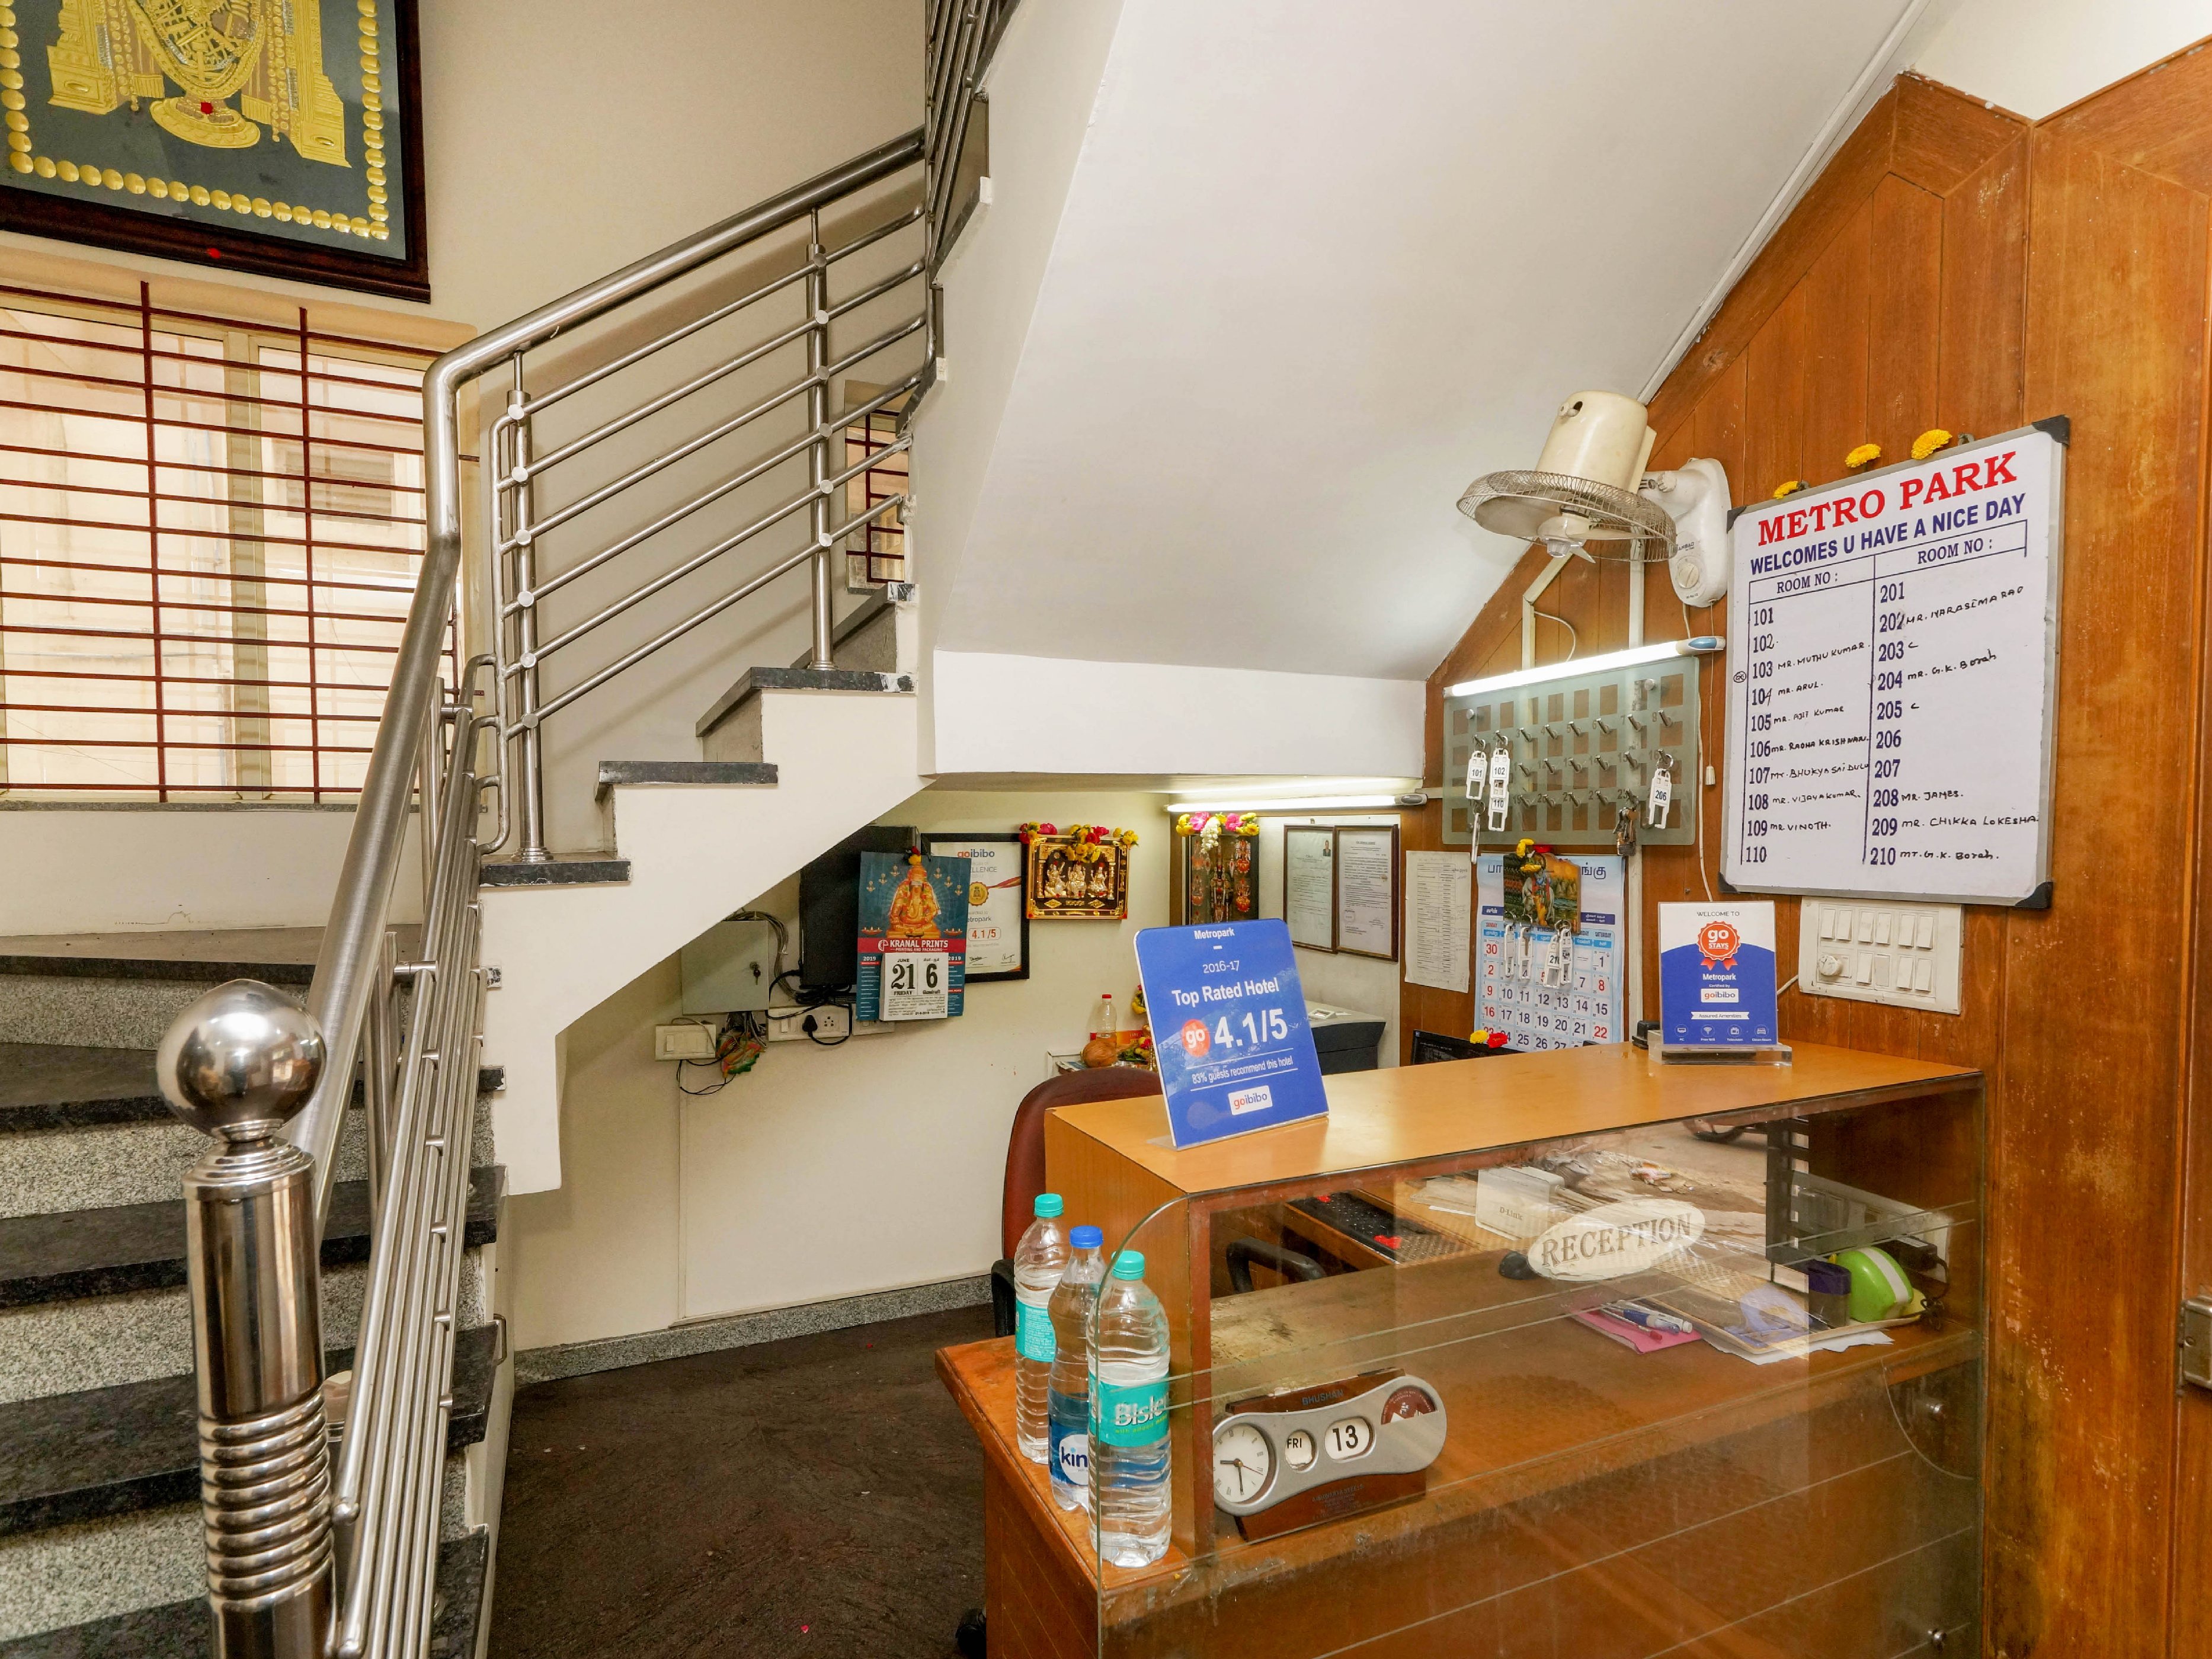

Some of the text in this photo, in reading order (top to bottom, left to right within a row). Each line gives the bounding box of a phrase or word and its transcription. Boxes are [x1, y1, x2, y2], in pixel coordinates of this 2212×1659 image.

[1758, 451, 2017, 546] METRO PARK
[1750, 493, 2026, 575] WELCOMES U HAVE A NICE DAY
[1918, 543, 1959, 564] ROOM
[1777, 577, 1810, 594] ROOM
[1880, 581, 1904, 603] 201
[1754, 607, 1774, 626] 101
[1797, 652, 1829, 666] MUTHU
[1878, 640, 1904, 662] 203
[1753, 661, 1773, 679] 103
[1878, 670, 1903, 691] 204
[1752, 688, 1772, 706] 104
[1877, 700, 1902, 720] 205
[1751, 713, 1772, 732] 105
[1876, 729, 1902, 749] 206
[1750, 741, 1771, 758] 106
[1472, 769, 1482, 777] 101
[1749, 767, 1771, 784] 107
[1874, 759, 1900, 779] 207
[1493, 800, 1504, 808] 110
[1655, 790, 1667, 800] 206
[1749, 793, 1769, 811] 108
[1873, 789, 1899, 807] 208
[1747, 820, 1768, 837] 109
[1872, 818, 1897, 836] 209
[1930, 817, 1977, 827] CHIKKA
[958, 849, 995, 859] goibibo
[1746, 846, 1767, 863] 110
[1870, 847, 1896, 865] 210
[1194, 927, 1235, 940] Metropark
[1708, 929, 1729, 943] go
[921, 940, 948, 948] PRINTS
[1486, 944, 1604, 968] 30 1
[926, 963, 938, 988] 6
[1202, 960, 1240, 973] 2016-17
[891, 963, 915, 989] 21
[1488, 965, 1494, 975] 2
[1579, 977, 1585, 988] 7
[1598, 979, 1605, 991] 8
[1171, 977, 1280, 1007] Top Rated Hotel
[1487, 985, 1608, 1016] 9 10 11 12 13 14 15
[1704, 991, 1736, 1000] goibibo
[1186, 1008, 1289, 1049] go 4.1/5
[1484, 1006, 1608, 1039] 16 17 18 19 20 21 22
[1518, 1033, 1529, 1046] 25
[1535, 1037, 1548, 1049] 26
[1192, 1055, 1294, 1084] 83% guests recommend this hotel
[1233, 1092, 1267, 1110] goibibo
[1500, 1206, 1523, 1221] D-Link
[1542, 1212, 1692, 1268] RECEPTION
[1302, 1389, 1345, 1406] BHUSHAN
[1287, 1438, 1302, 1449] FRI
[1333, 1424, 1359, 1452] 13
